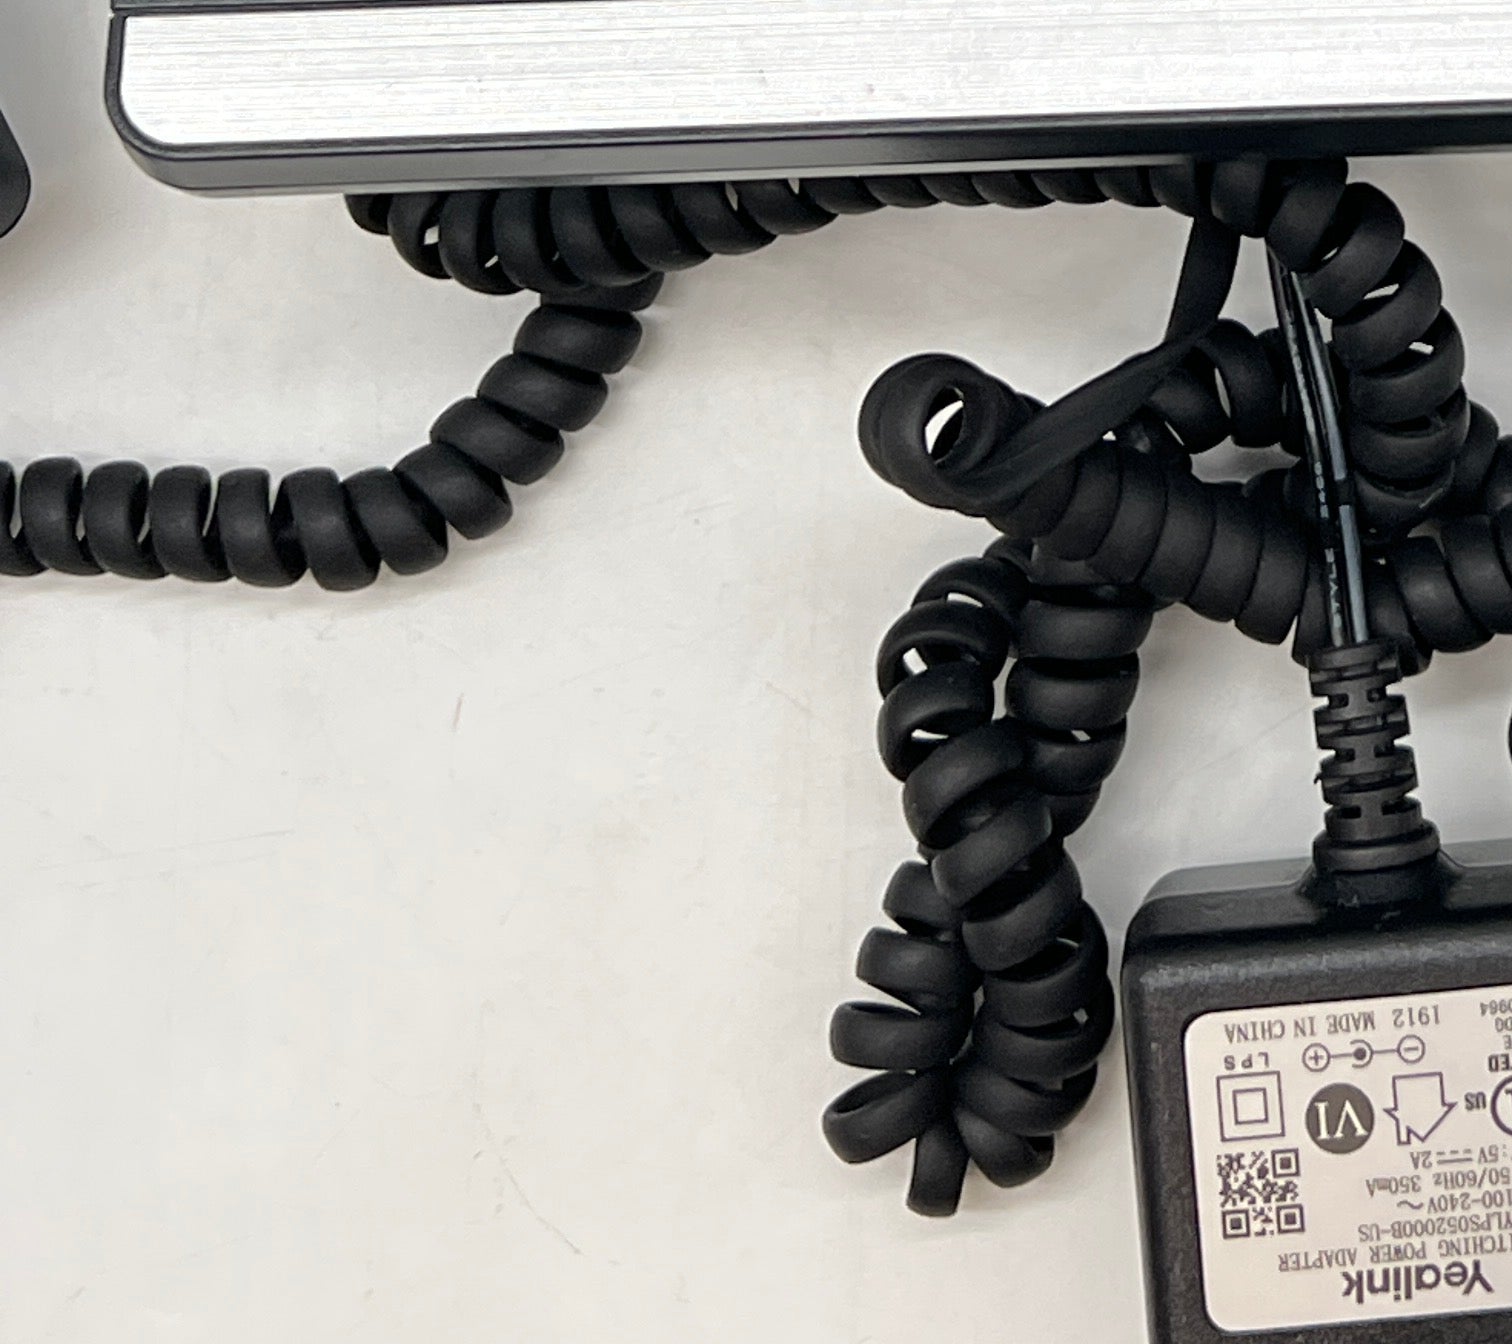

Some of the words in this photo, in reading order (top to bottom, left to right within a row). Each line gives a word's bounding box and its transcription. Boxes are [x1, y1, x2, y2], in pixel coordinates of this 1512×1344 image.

[1293, 1015, 1318, 1039] IN
[1326, 1010, 1376, 1035] MADE
[1391, 1004, 1440, 1028] 1912
[1223, 1019, 1286, 1044] CHINA
[1313, 1098, 1369, 1140] VI
[1409, 1150, 1433, 1170] 2A
[1365, 1173, 1422, 1198] 350mA
[1277, 1247, 1358, 1272] ADAPTER
[1368, 1240, 1427, 1264] POWER
[1342, 1258, 1495, 1305] Yealink
